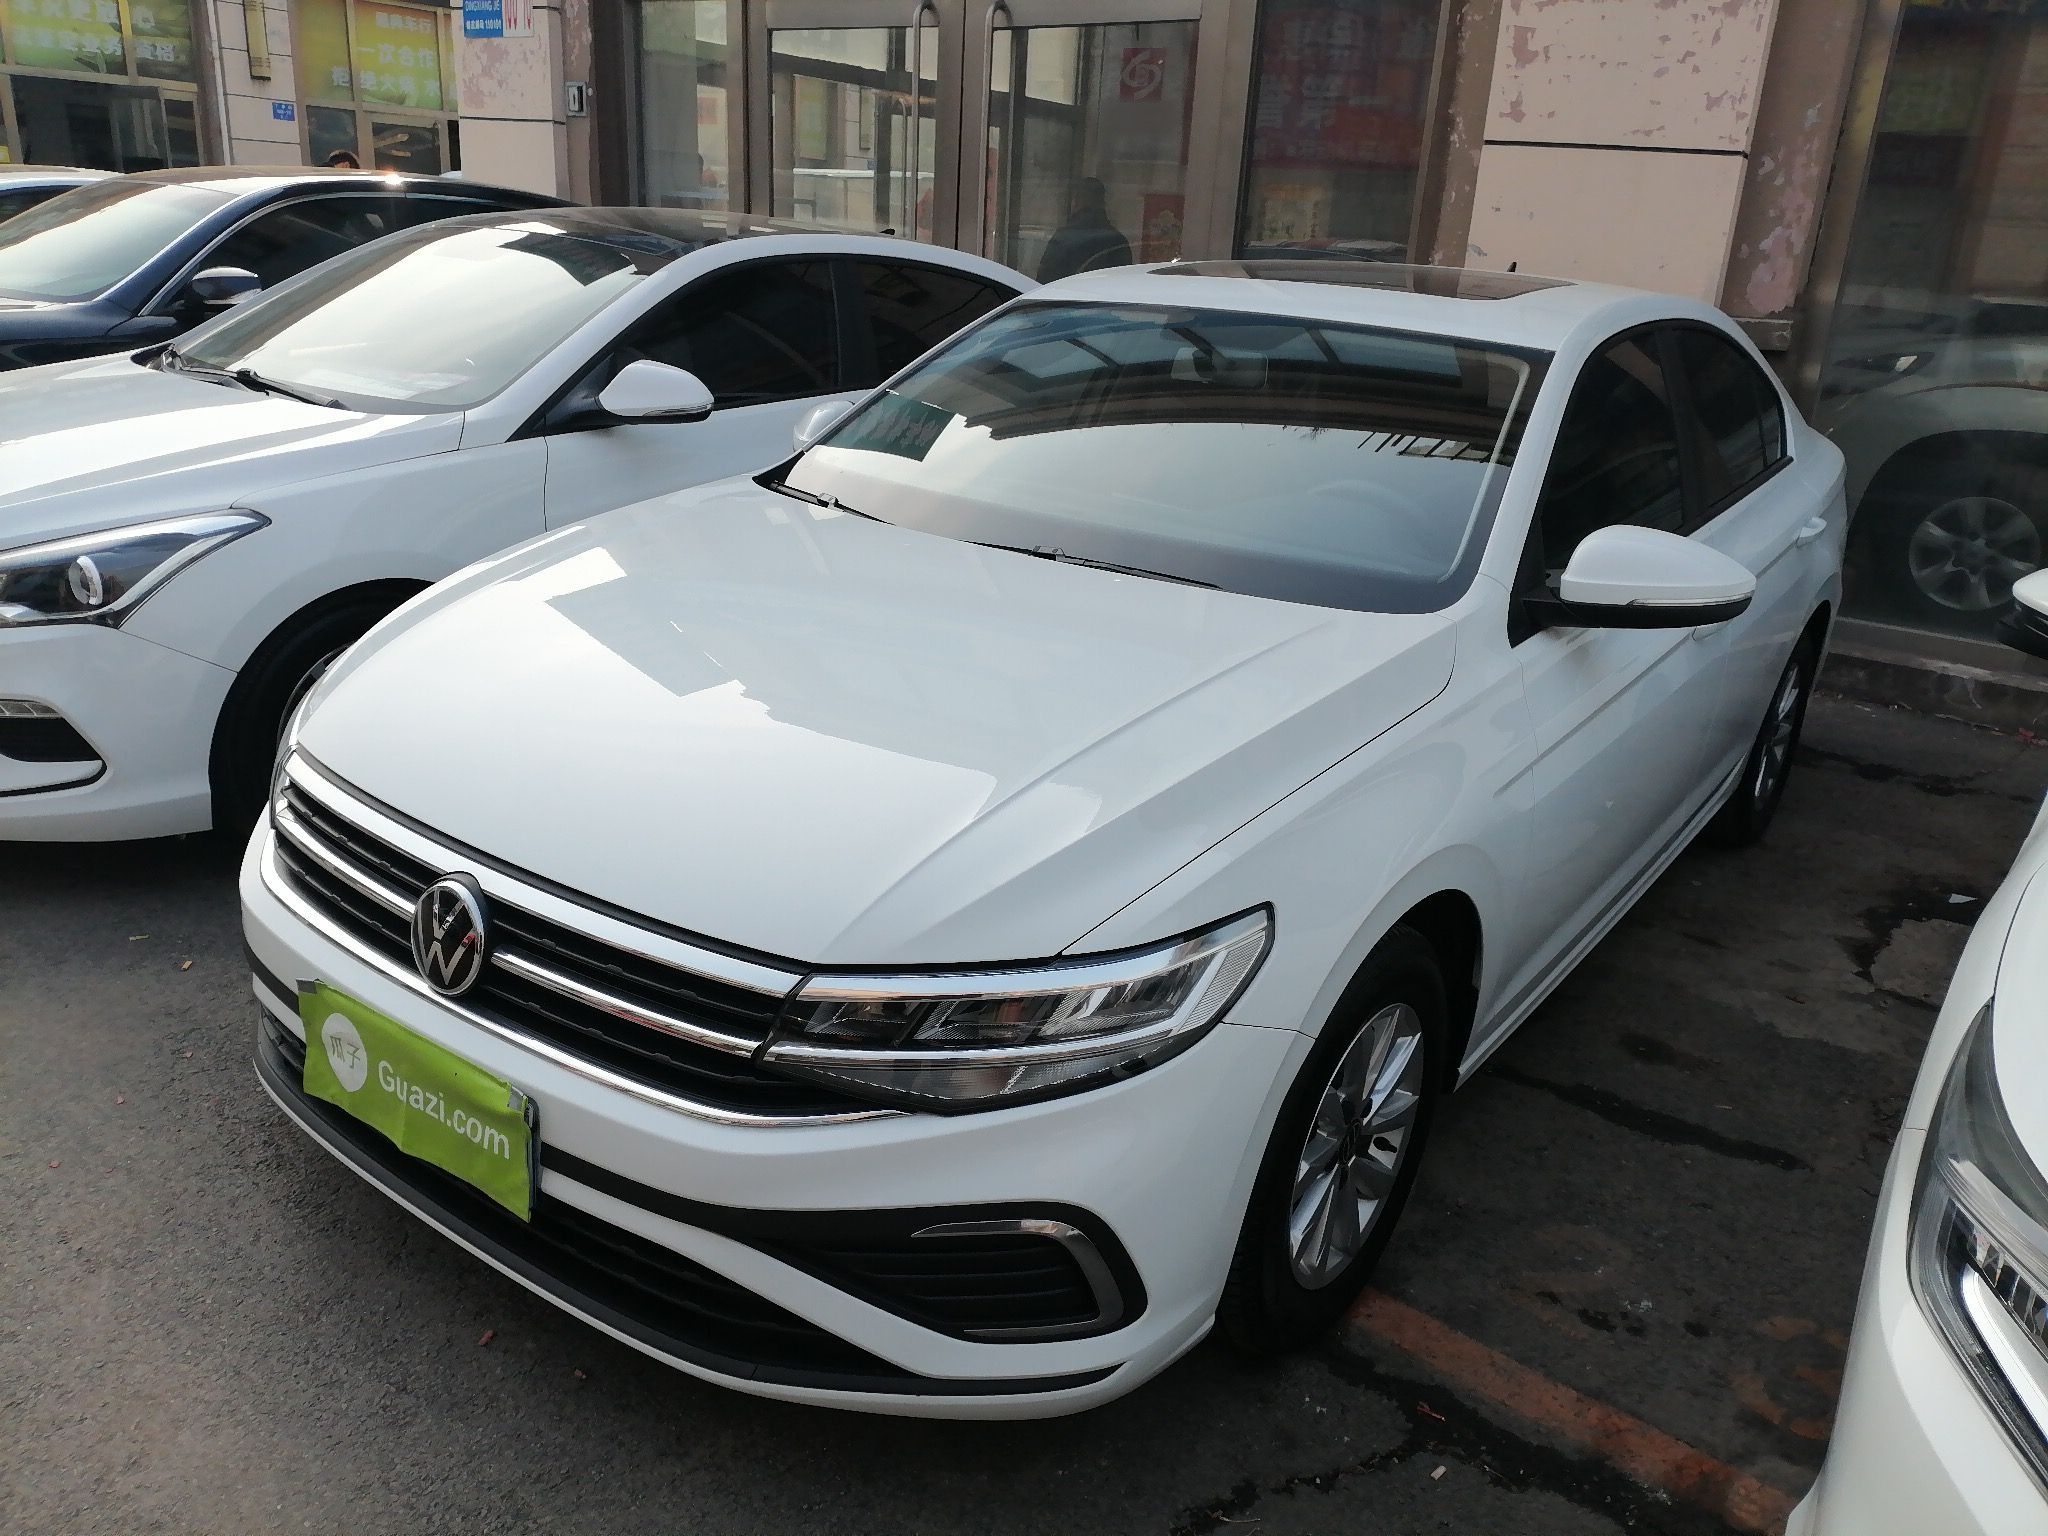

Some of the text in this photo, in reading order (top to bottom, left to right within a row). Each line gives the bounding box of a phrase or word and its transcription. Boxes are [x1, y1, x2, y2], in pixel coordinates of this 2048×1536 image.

[375, 11, 431, 34] 车行
[329, 1032, 361, 1069] 瓜子
[378, 1059, 510, 1160] Guazi.com
